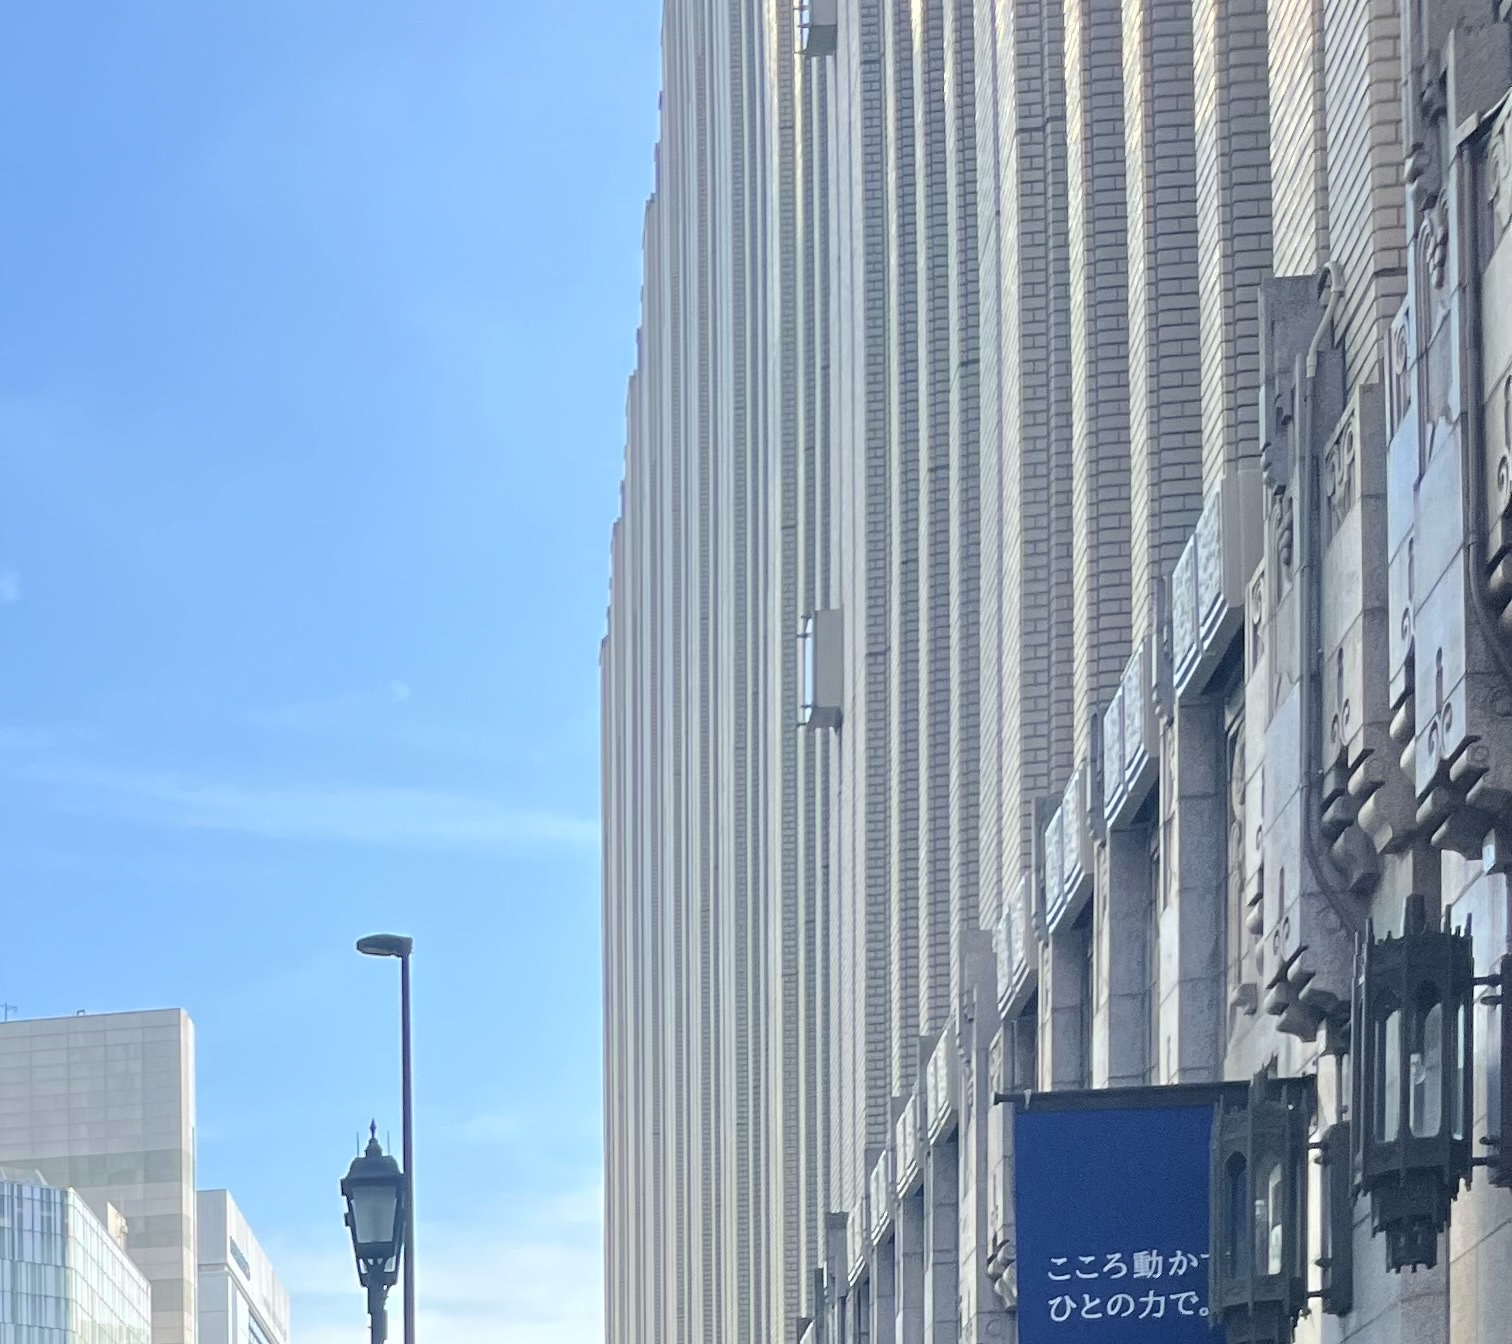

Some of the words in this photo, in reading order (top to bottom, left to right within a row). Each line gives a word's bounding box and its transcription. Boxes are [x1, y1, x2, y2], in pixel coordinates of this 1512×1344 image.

[1047, 1250, 1210, 1281] こころ動か
[1047, 1290, 1210, 1322] ひとの力で。
